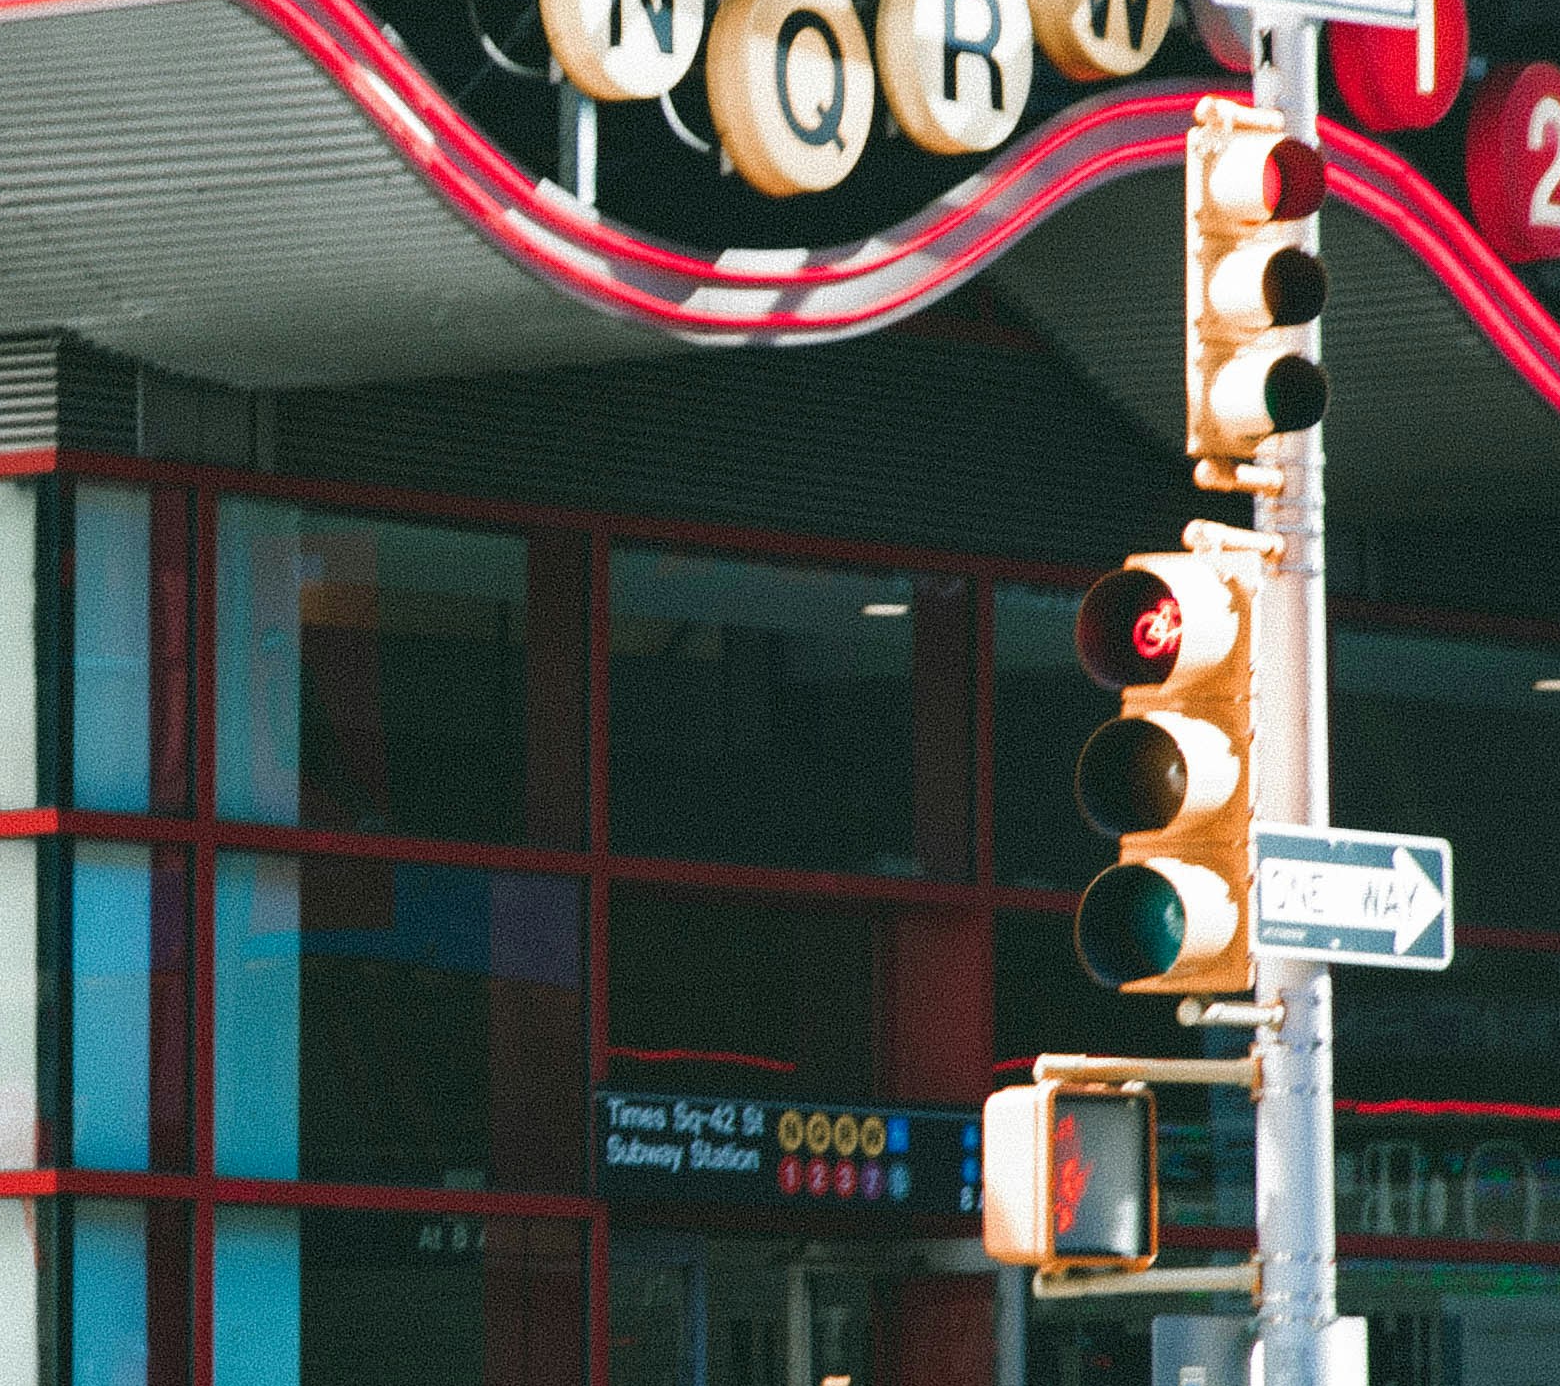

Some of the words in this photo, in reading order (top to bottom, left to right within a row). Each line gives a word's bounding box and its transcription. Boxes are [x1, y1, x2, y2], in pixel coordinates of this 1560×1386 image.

[776, 10, 846, 152] Q
[607, 1097, 667, 1131] Times
[607, 1133, 684, 1173] Subway
[691, 1137, 761, 1173] Station
